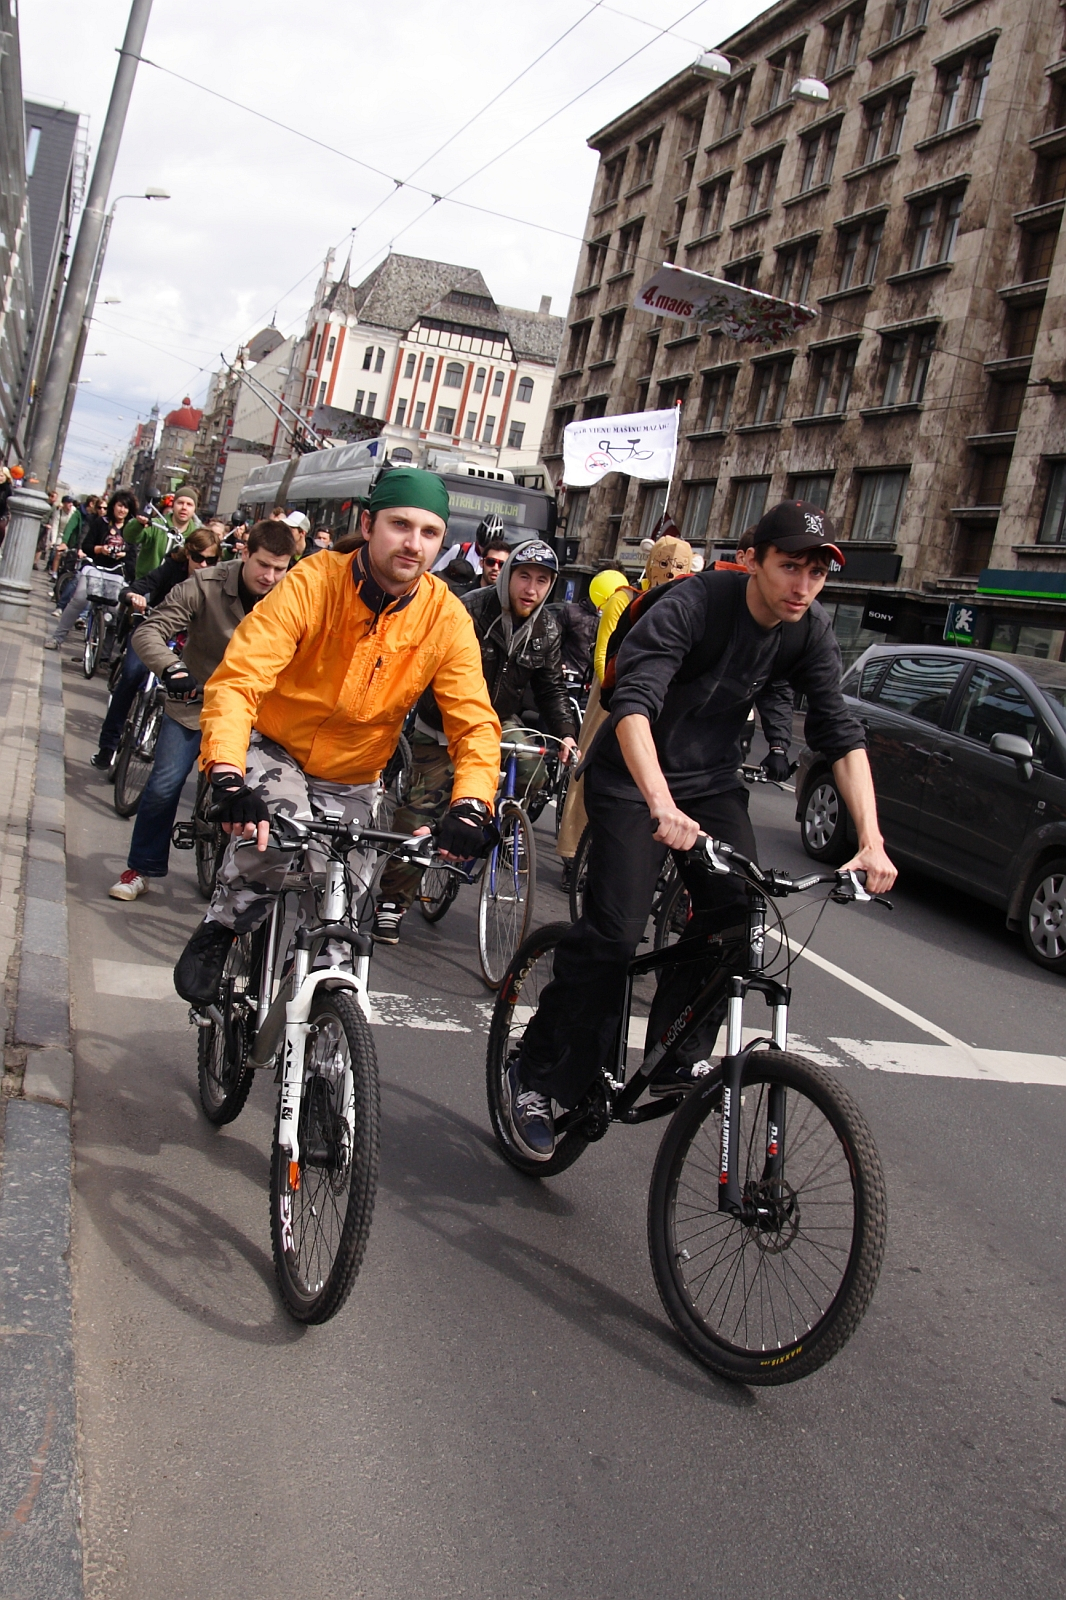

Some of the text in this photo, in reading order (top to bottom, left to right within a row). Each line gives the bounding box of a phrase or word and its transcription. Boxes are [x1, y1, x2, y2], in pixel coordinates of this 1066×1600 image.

[655, 294, 694, 316] maijs
[484, 500, 519, 517] STACIJA
[868, 610, 894, 622] SONY
